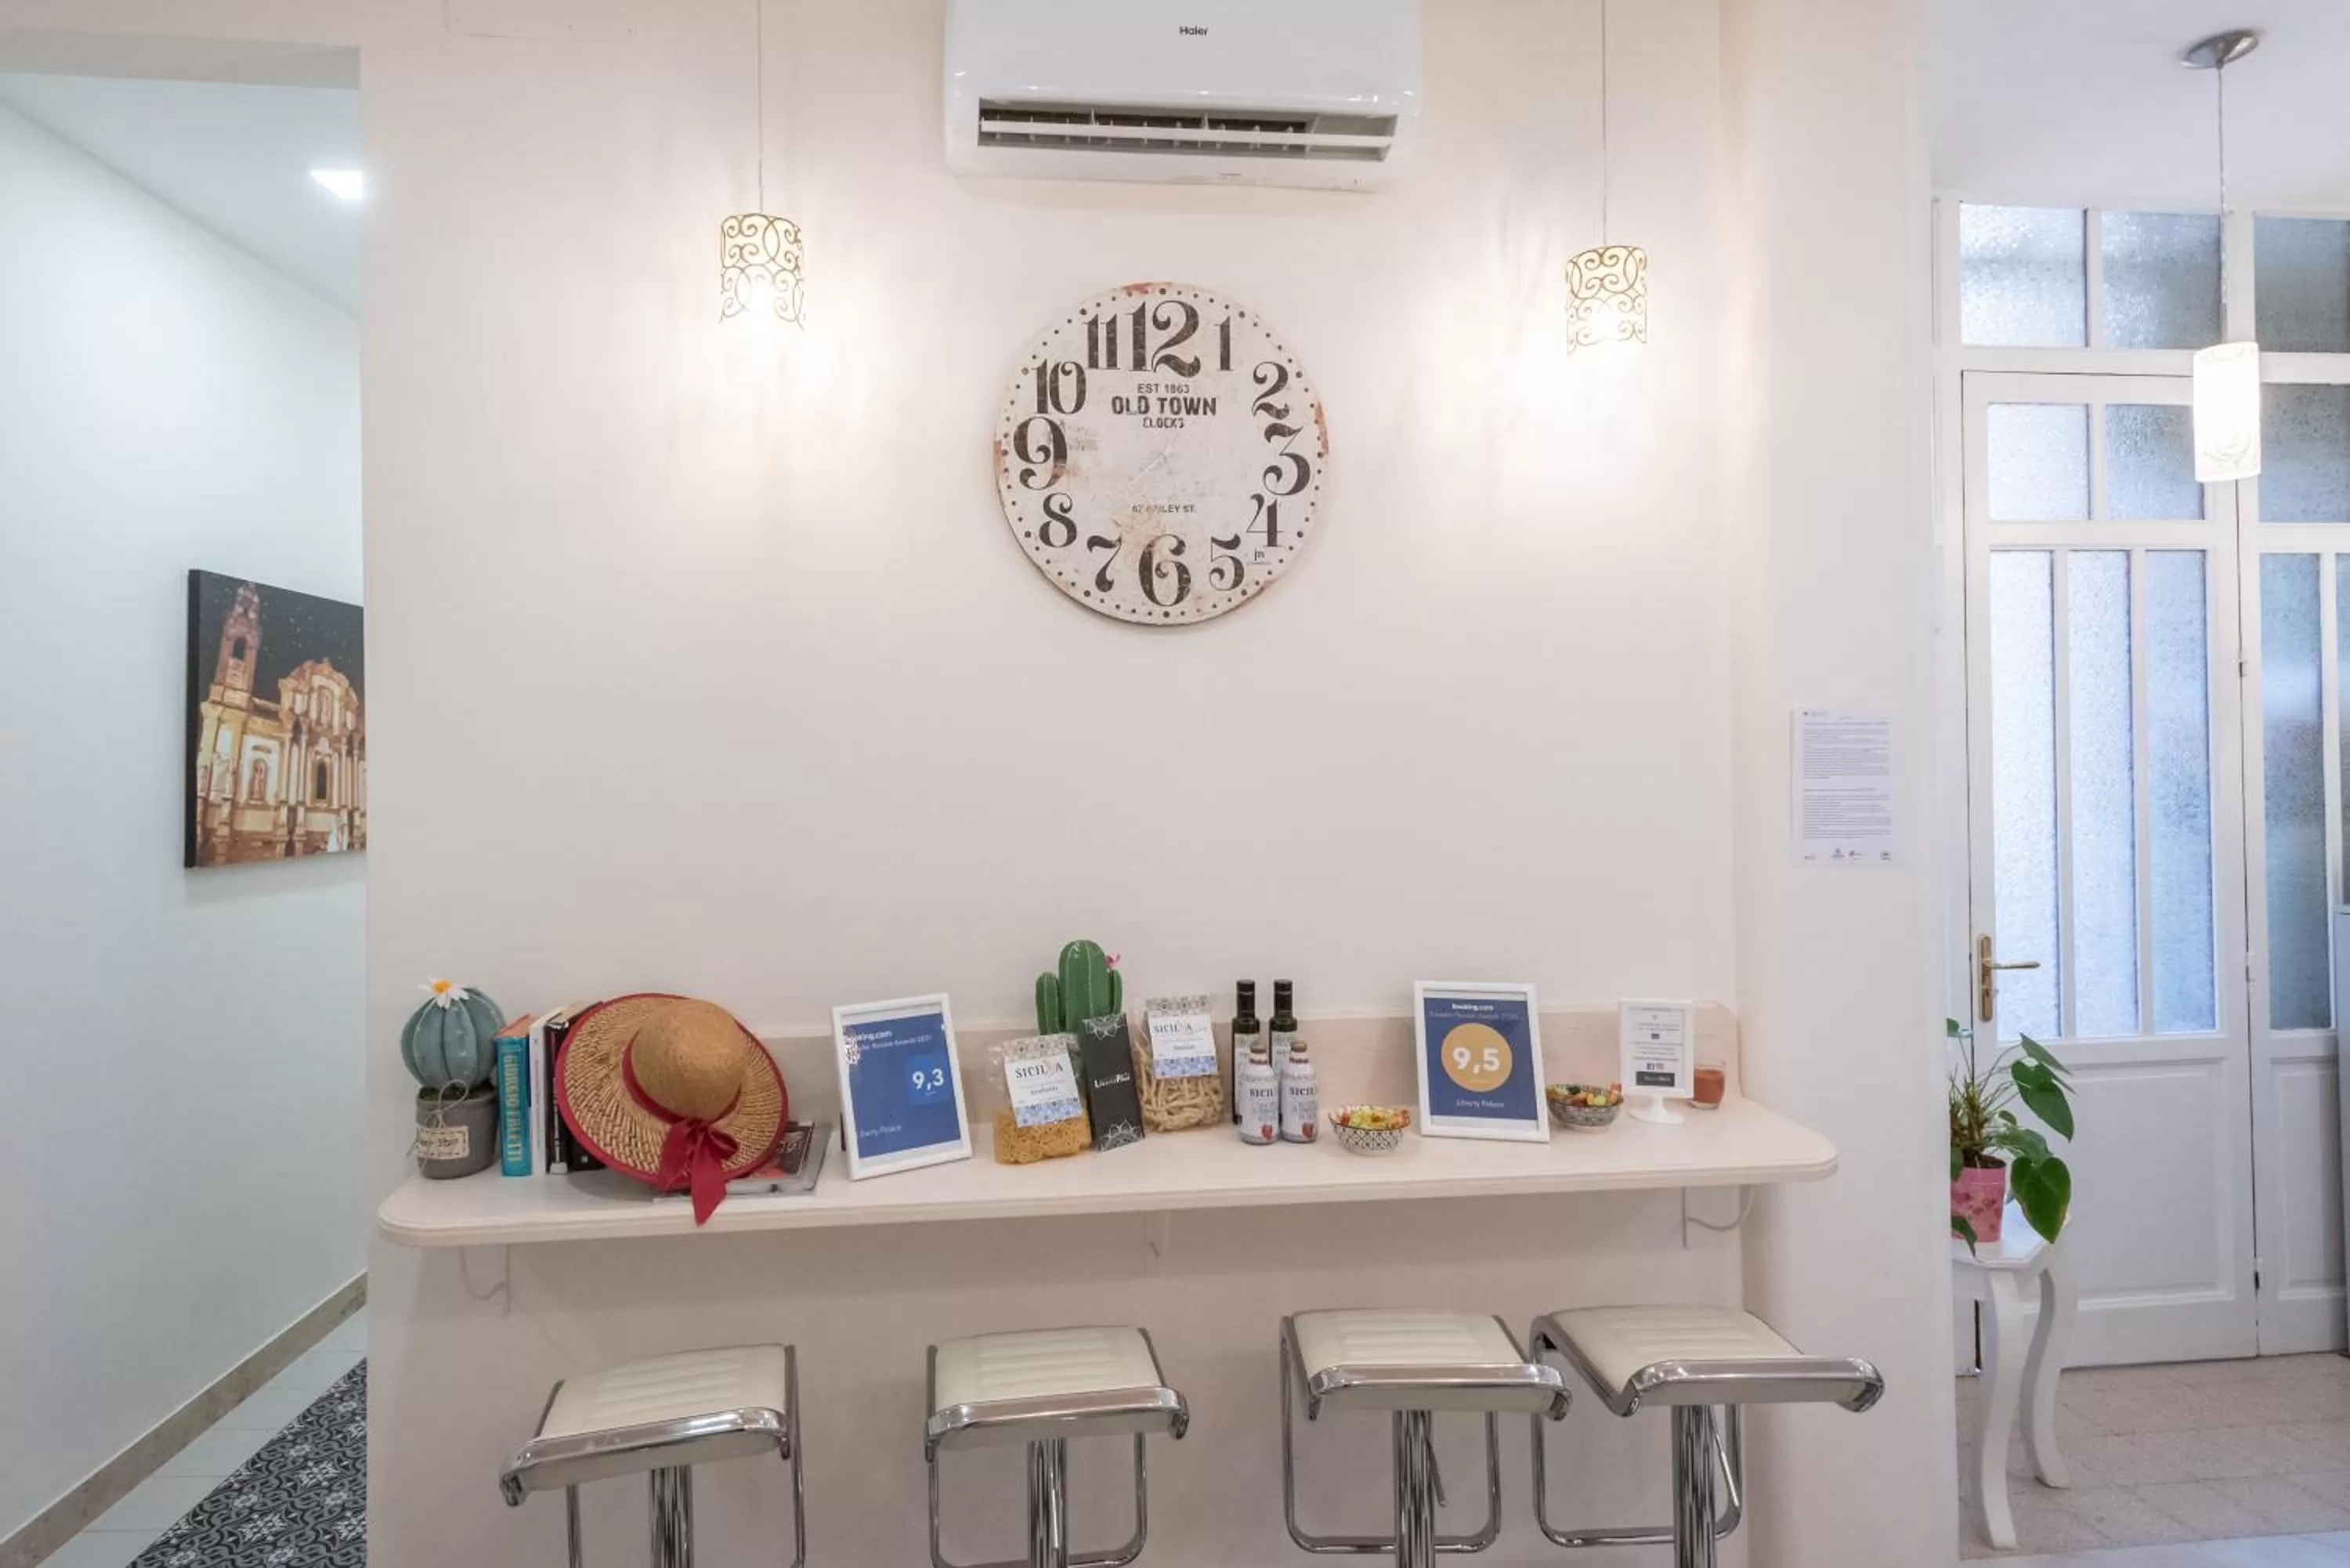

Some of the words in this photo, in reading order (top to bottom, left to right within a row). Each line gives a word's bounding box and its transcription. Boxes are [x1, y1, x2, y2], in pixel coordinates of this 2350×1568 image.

[1180, 25, 1209, 37] Haier
[1083, 313, 1120, 370] 11
[1126, 300, 1201, 378] 12
[1215, 316, 1235, 371] 1
[1032, 359, 1086, 414] 10
[1112, 396, 1150, 415] OLD
[1156, 396, 1217, 417] TOWN
[1137, 383, 1160, 394] EST
[1253, 361, 1290, 420] 2
[1143, 417, 1184, 428] CLOCKS
[1014, 417, 1068, 490] 9
[1262, 422, 1311, 496] 3
[1039, 493, 1077, 547] 8
[1246, 493, 1284, 547] 4
[1086, 534, 1123, 593] 7
[1138, 533, 1191, 606] 6
[1209, 533, 1245, 591] 5
[912, 1068, 944, 1090] 9,3
[1452, 1046, 1500, 1075] 9,5
